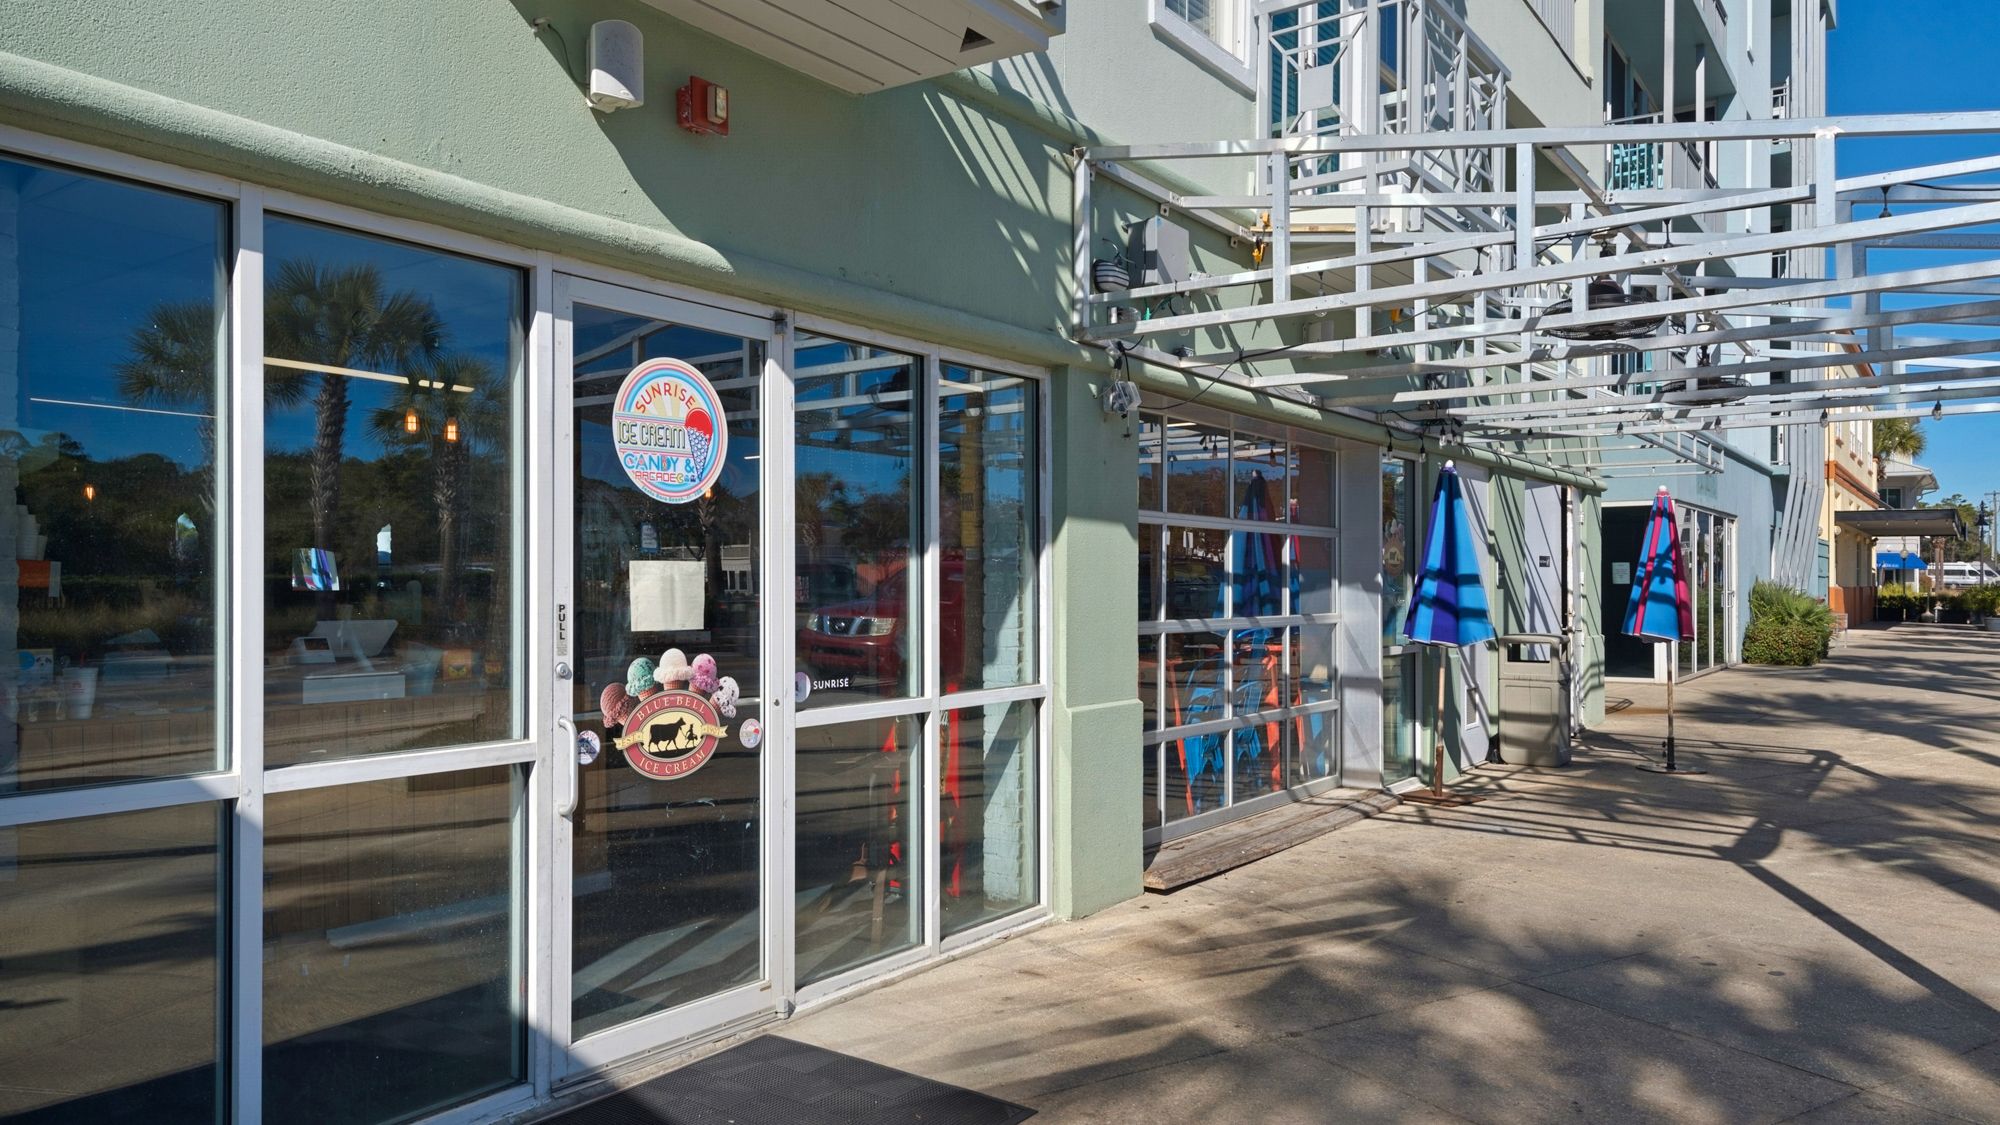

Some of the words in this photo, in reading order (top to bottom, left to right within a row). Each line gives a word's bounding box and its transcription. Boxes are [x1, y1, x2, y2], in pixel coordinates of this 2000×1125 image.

[635, 382, 696, 413] SUNRISE
[618, 420, 638, 445] ICE
[640, 422, 686, 449] CREAM
[623, 453, 679, 472] CANDY
[684, 458, 695, 473] &
[634, 471, 677, 482] ARCADE
[558, 604, 566, 640] PULL
[813, 677, 849, 690] SUNRISE
[636, 697, 671, 721] BLUE
[676, 695, 705, 714] BELL
[639, 757, 660, 773] ICE
[665, 750, 706, 774] CREAM
